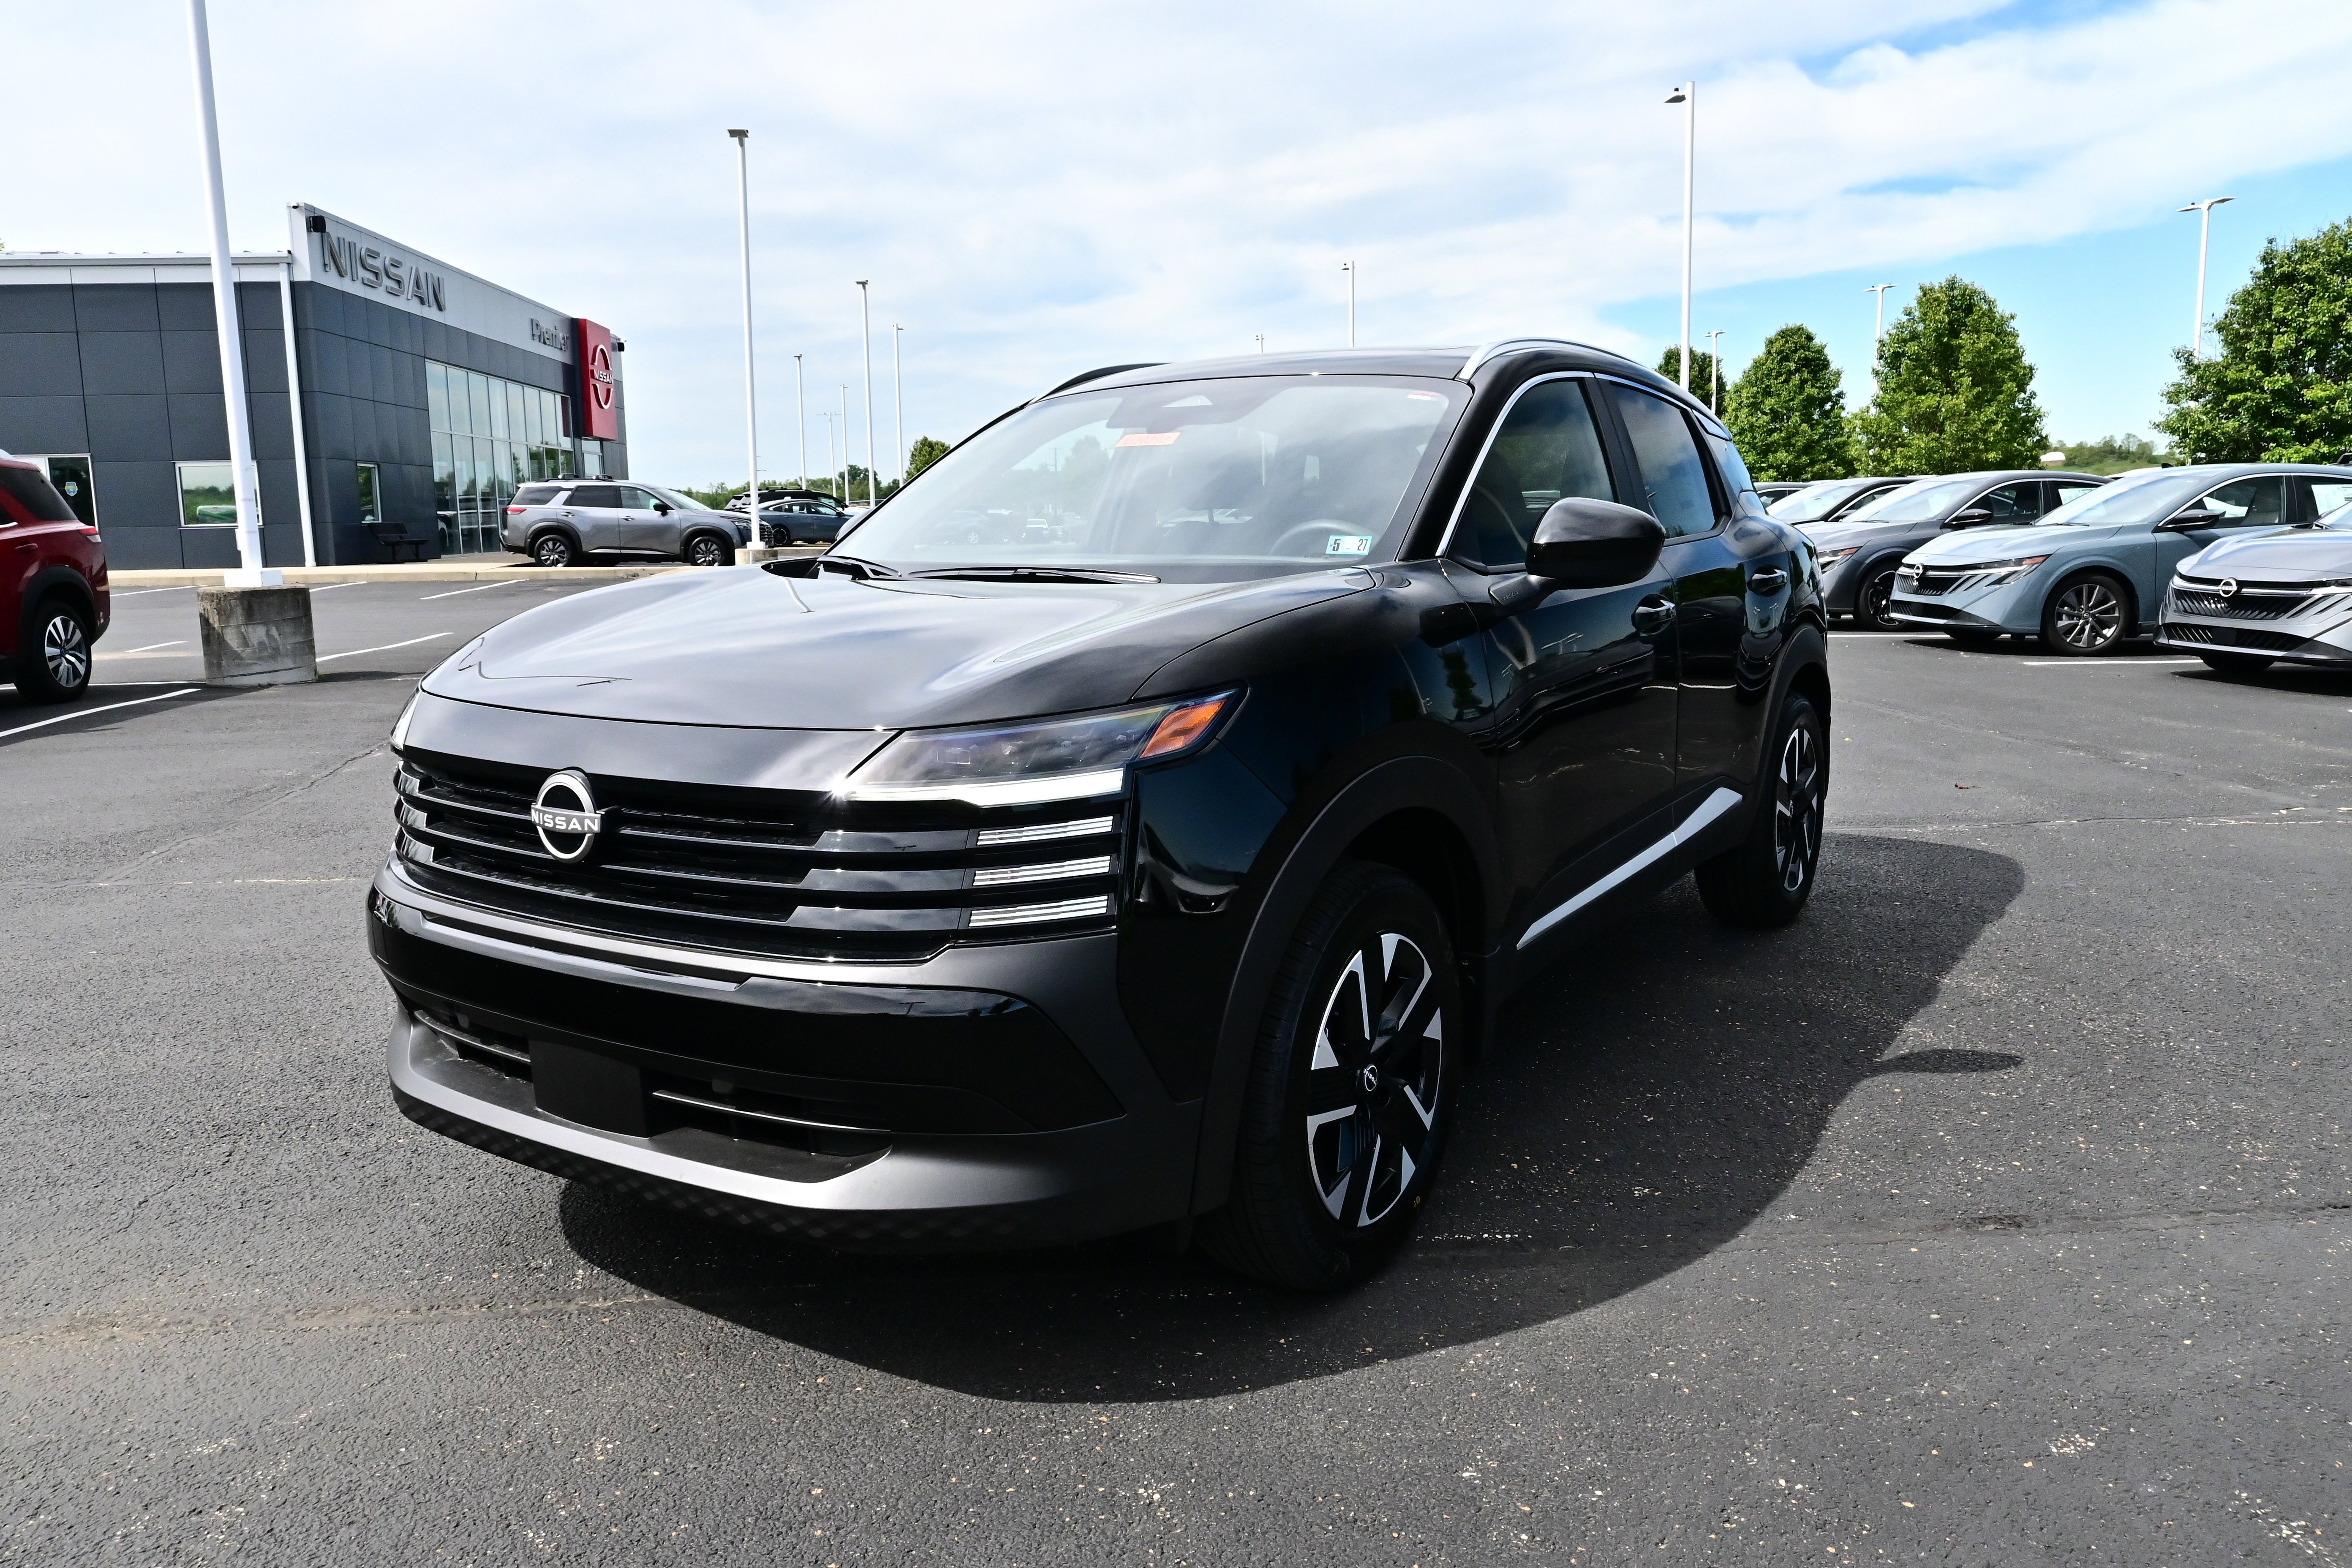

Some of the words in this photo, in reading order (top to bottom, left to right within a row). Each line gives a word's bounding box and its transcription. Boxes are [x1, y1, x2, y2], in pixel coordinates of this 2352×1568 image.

[321, 232, 446, 312] NISSAN
[531, 318, 569, 351] Premier
[593, 369, 614, 384] NISSAN
[1332, 539, 1341, 552] 5
[1357, 539, 1368, 551] 27
[531, 809, 598, 831] NISSAN
[1364, 1069, 1377, 1087] NISSAN
